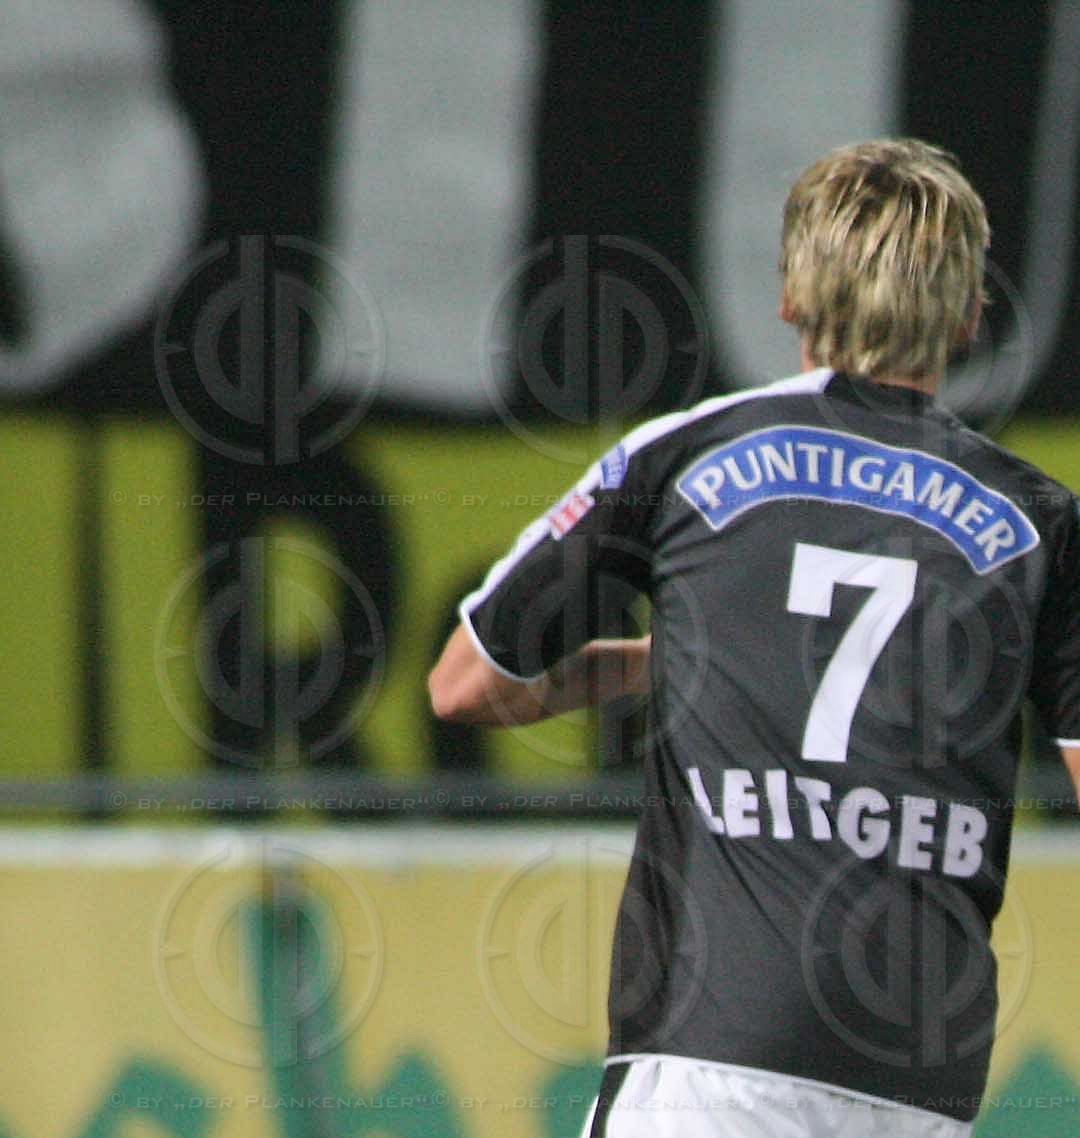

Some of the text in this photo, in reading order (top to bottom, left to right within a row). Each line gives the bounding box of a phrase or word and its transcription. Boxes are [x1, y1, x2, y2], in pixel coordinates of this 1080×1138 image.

[689, 440, 1017, 562] PUNTIGAMER
[786, 542, 918, 763] 7
[687, 766, 988, 878] LEITGEB
